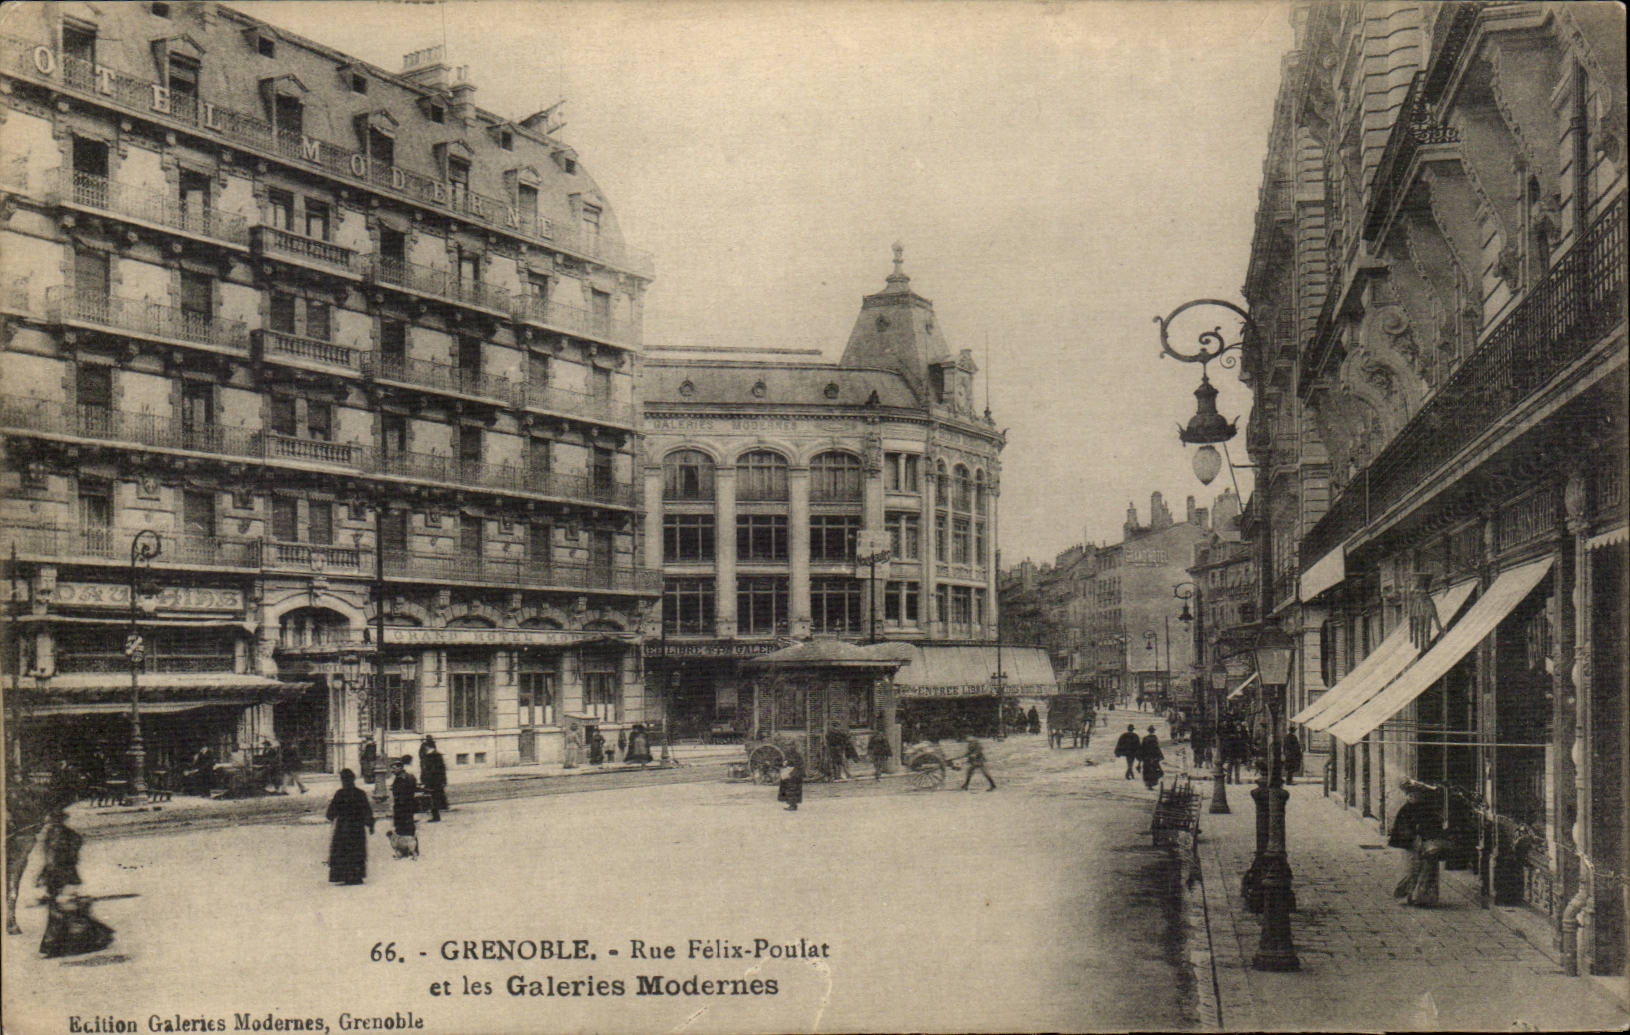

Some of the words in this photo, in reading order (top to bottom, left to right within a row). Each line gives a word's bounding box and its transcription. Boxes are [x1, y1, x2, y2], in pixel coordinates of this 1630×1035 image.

[301, 137, 553, 240] MODERNE
[653, 419, 714, 431] GALERIES
[732, 420, 797, 432] MODERNES
[393, 630, 457, 641] GRAND
[473, 631, 533, 642] HOTEL
[665, 645, 706, 656] LIBRE
[918, 686, 959, 697] ENTREE
